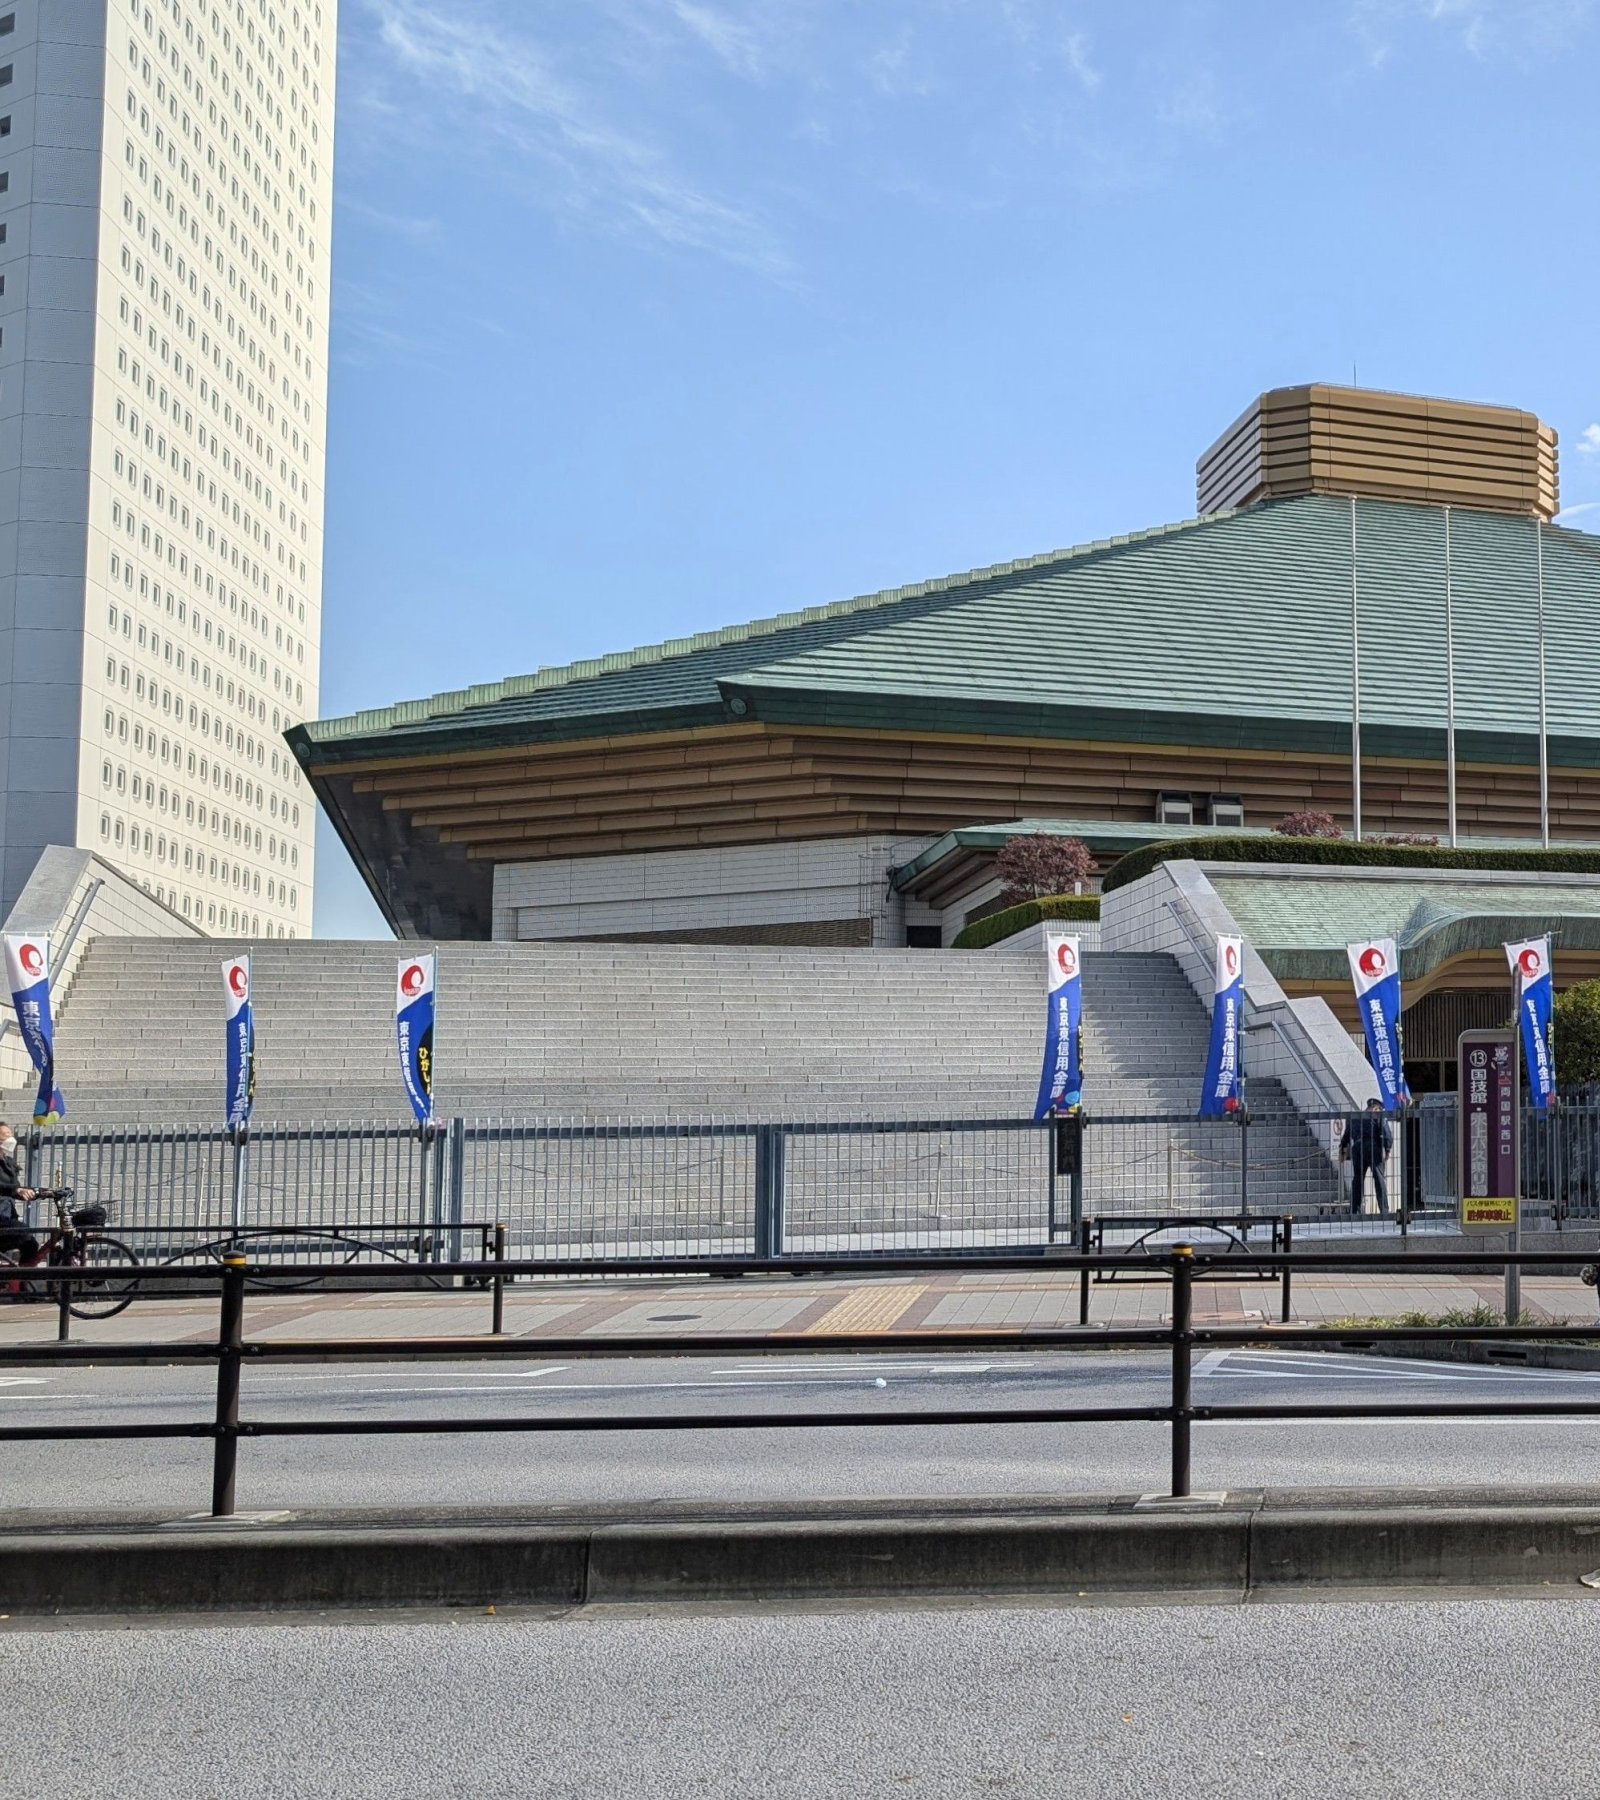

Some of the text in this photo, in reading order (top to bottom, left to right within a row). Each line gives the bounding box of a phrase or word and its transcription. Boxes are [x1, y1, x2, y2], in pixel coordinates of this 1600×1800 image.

[1050, 997, 1070, 1099] 東京東信用金庫
[1214, 998, 1236, 1098] 東京東信用金庫
[1369, 998, 1397, 1094] 東京東信用金庫
[1500, 1086, 1511, 1155] 両国駅西口
[1467, 1209, 1512, 1221] 駐停車禁止
